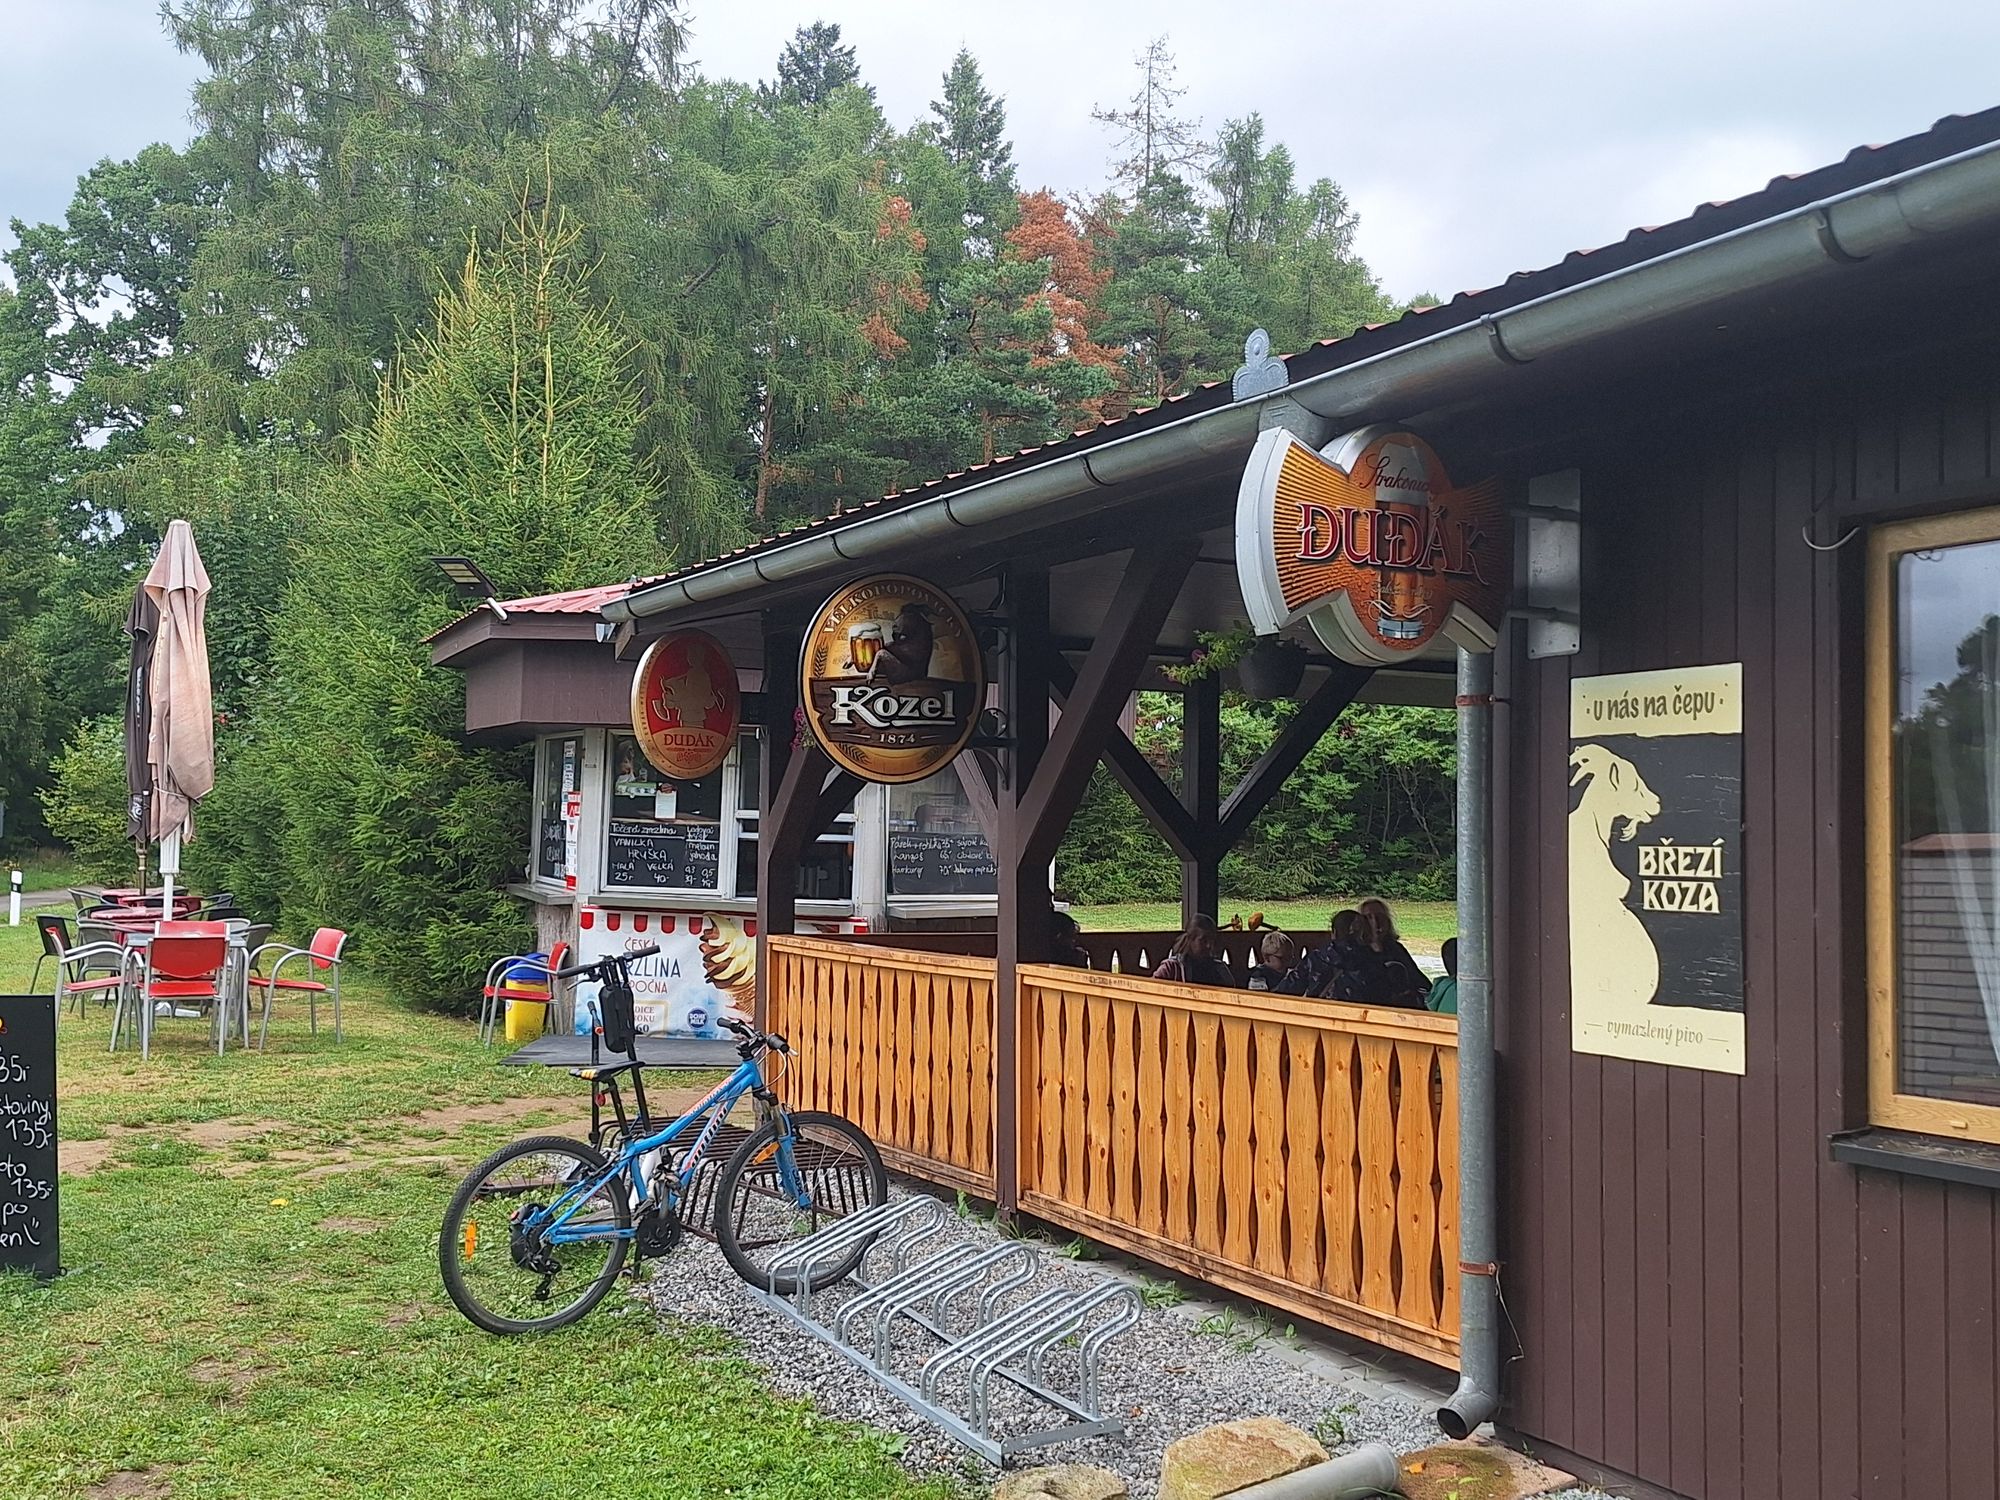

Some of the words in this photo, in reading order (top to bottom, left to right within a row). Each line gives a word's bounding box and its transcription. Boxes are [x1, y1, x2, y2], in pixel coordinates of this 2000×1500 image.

[1296, 502, 1489, 586] DUDÁK
[830, 686, 956, 728] Kozel
[1593, 699, 1603, 721] u
[1607, 689, 1639, 721] nás
[1643, 695, 1668, 718] na
[1672, 684, 1715, 721] čepu
[663, 732, 716, 747] DUDÁK
[879, 733, 916, 744] 1874
[1638, 837, 1726, 879] BŘEZÍ
[1642, 879, 1721, 914] KOZA
[624, 956, 681, 978] RZLINA
[628, 979, 668, 994] POČNA
[634, 1014, 656, 1023] OKU
[635, 1024, 650, 1033] 60
[1606, 1019, 1673, 1046] vymazlený
[1675, 1026, 1704, 1047] pivo
[3, 1202, 29, 1226] po
